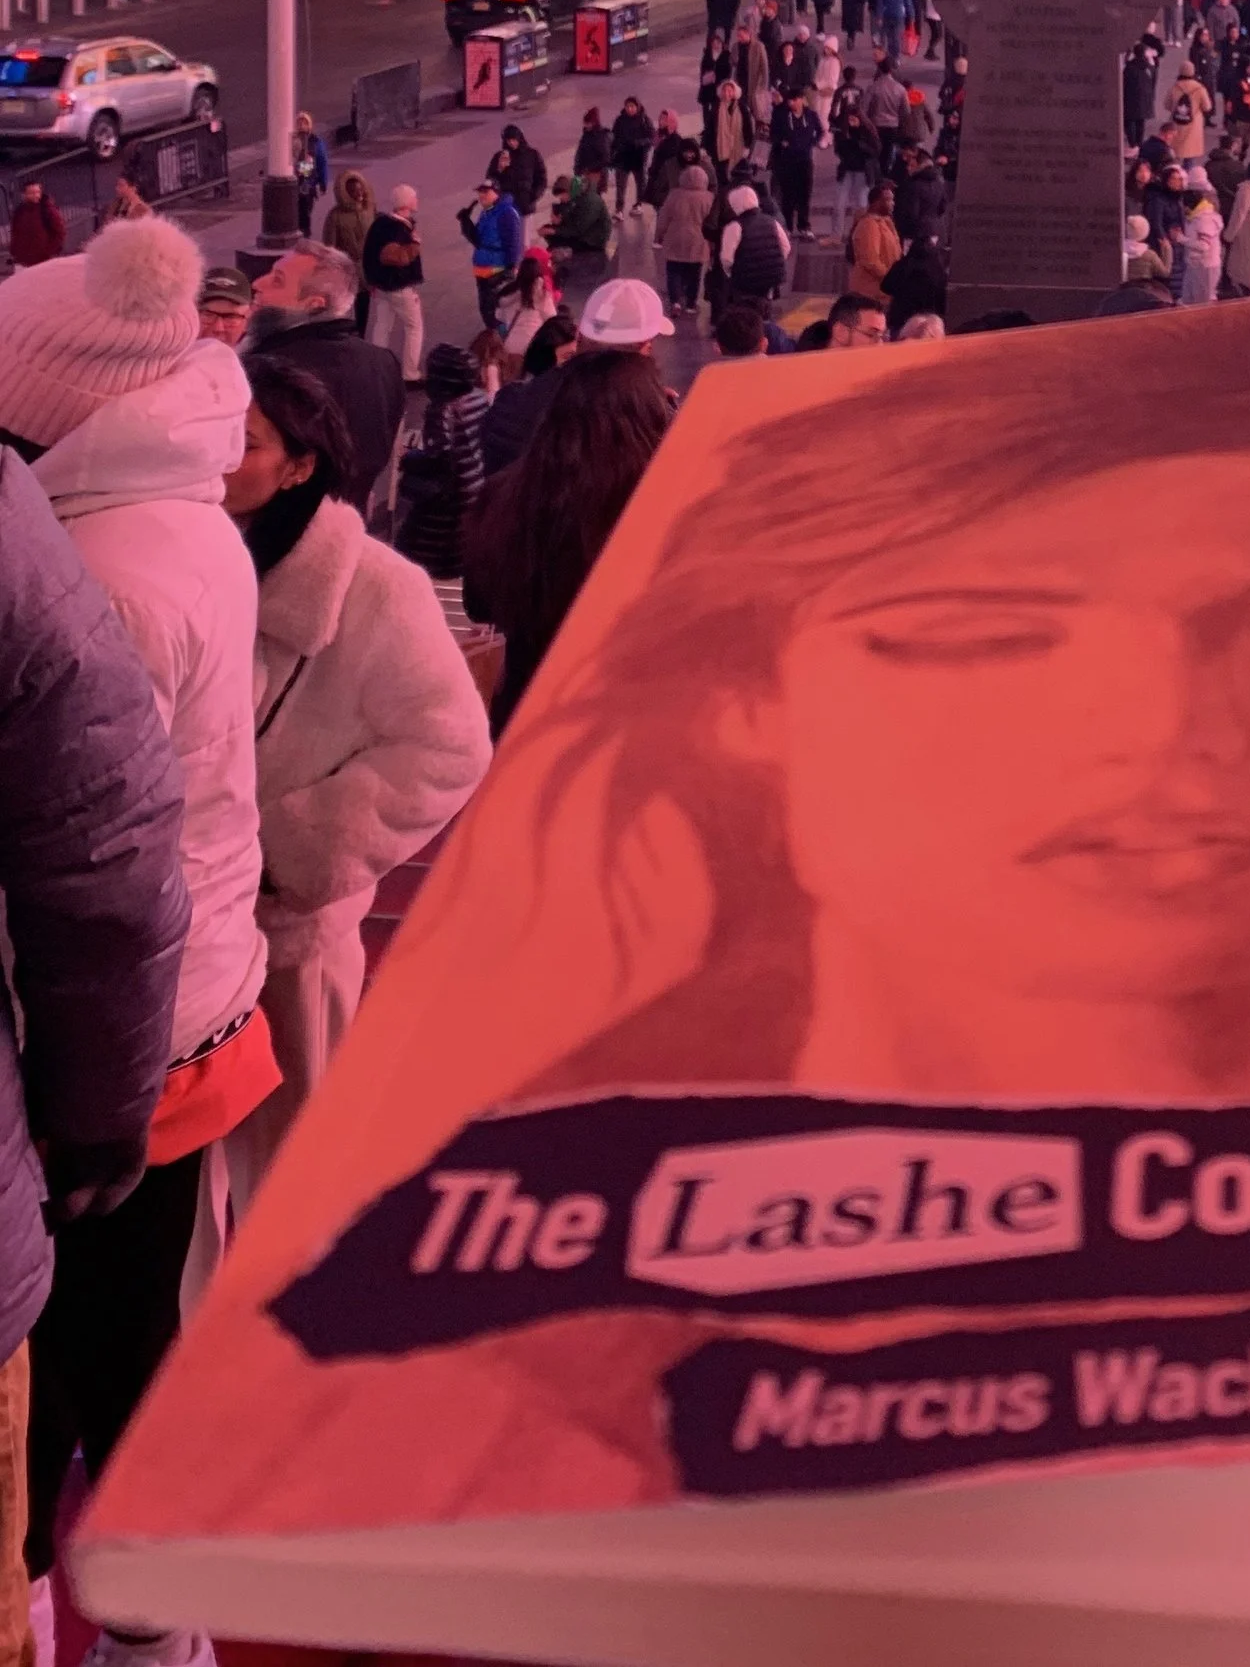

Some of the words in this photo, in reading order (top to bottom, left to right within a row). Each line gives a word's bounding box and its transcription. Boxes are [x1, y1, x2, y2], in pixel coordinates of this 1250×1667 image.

[410, 1168, 610, 1275] The
[648, 1158, 1063, 1260] Lashe
[732, 1368, 1055, 1453] Marcus
